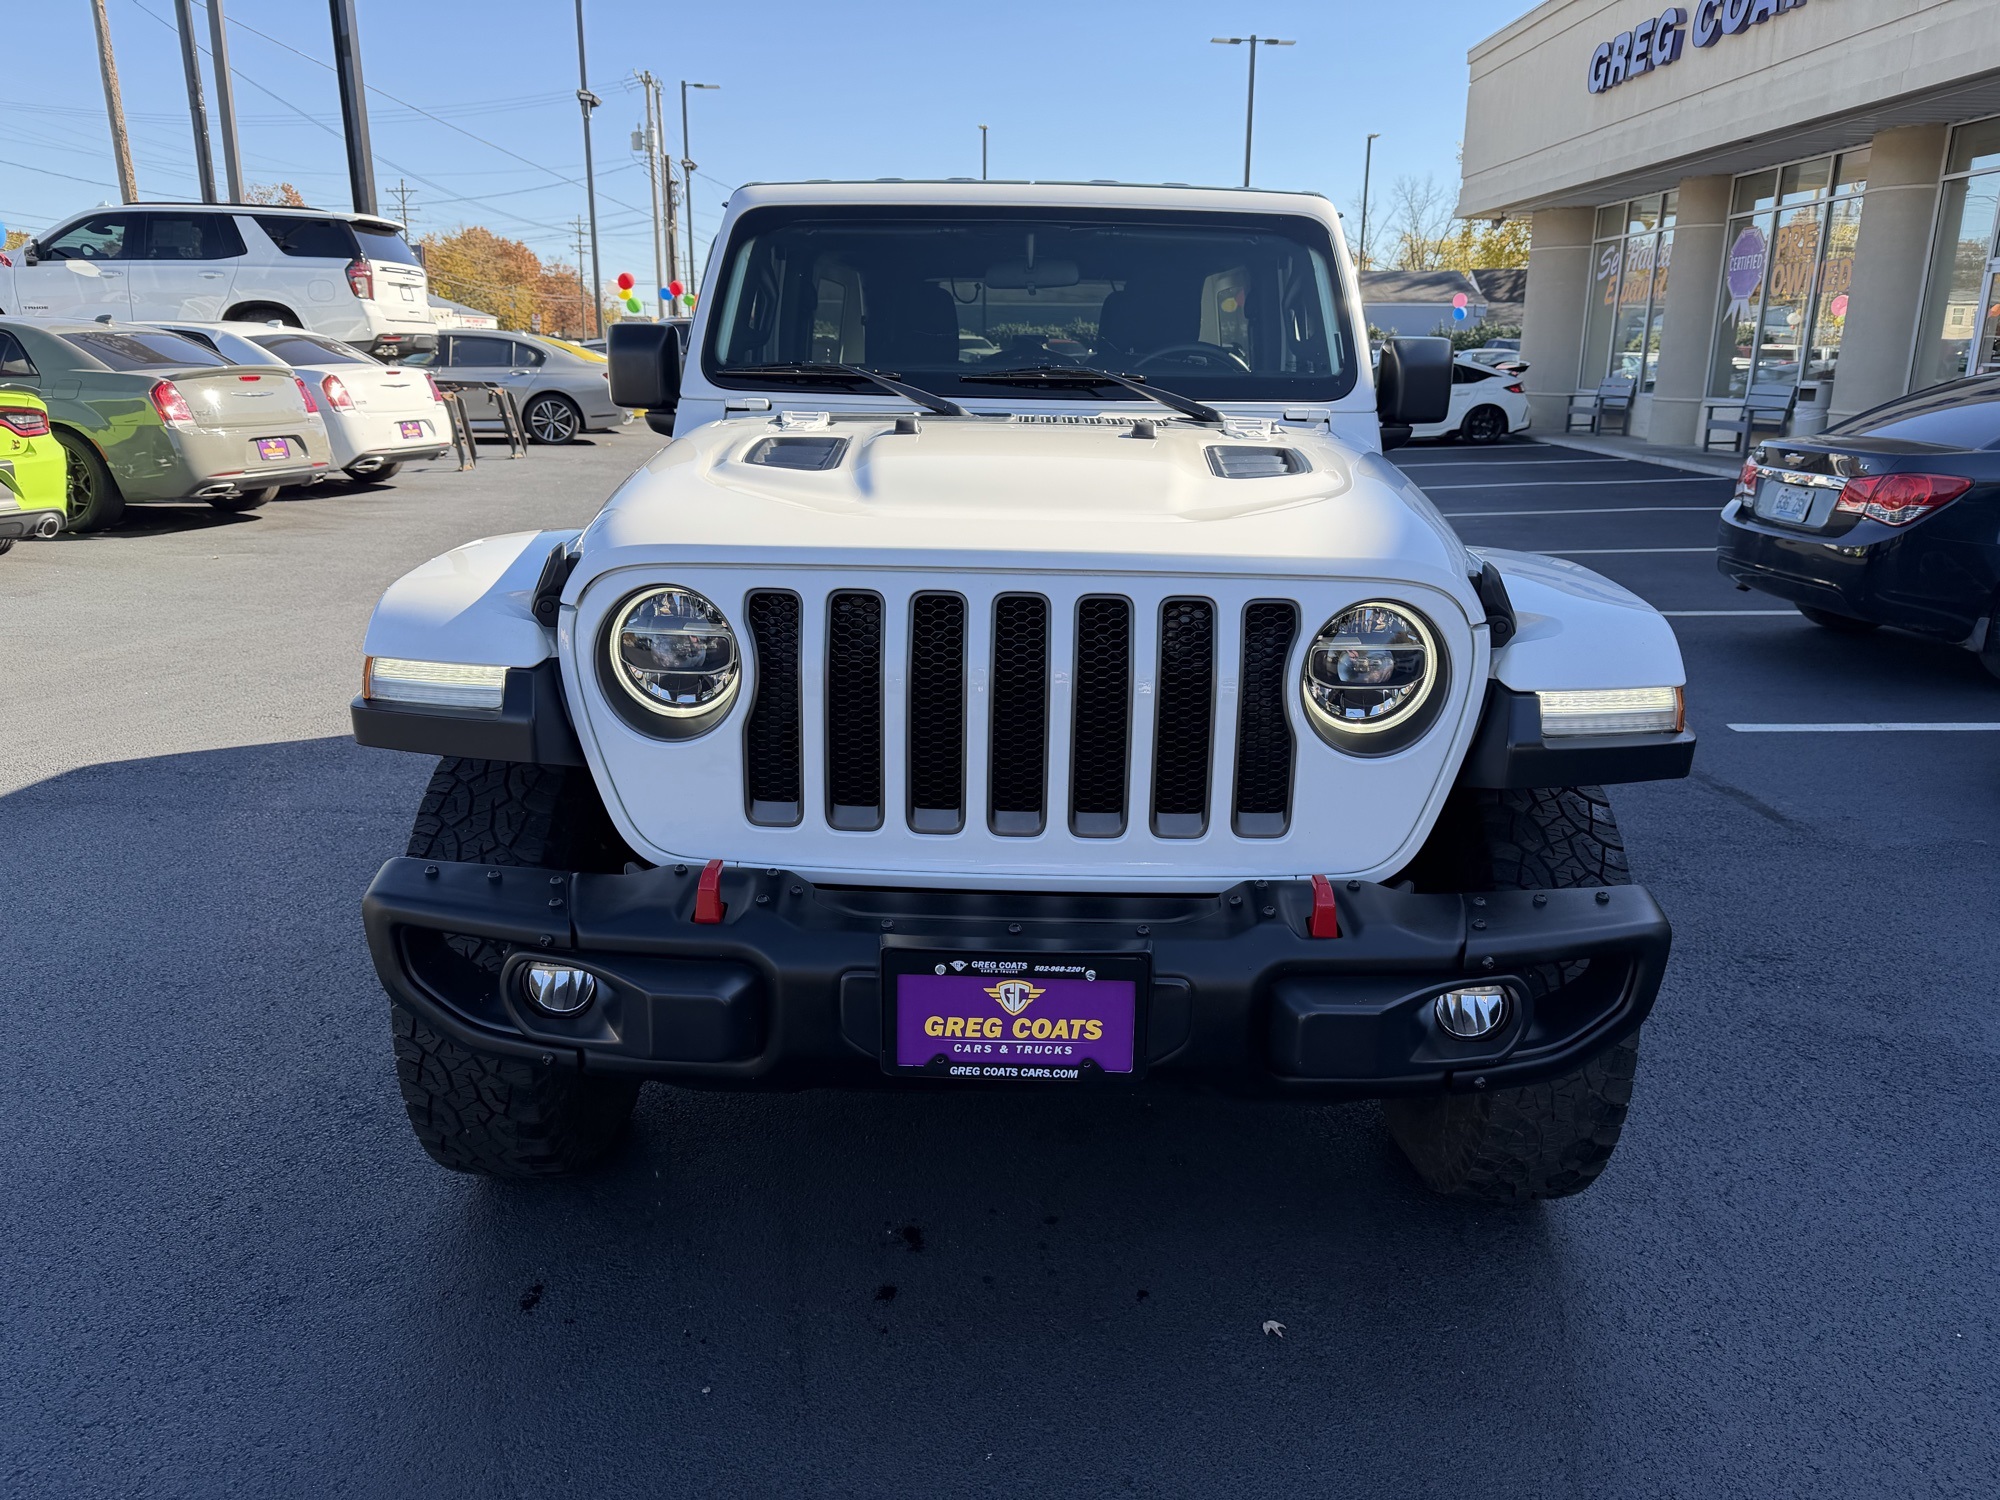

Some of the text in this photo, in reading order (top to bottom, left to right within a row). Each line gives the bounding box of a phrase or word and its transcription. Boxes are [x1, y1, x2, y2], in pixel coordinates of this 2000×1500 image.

[1588, 0, 1802, 95] GREG CO
[1775, 222, 1819, 260] PRE
[1597, 245, 1620, 281] Se
[1729, 253, 1763, 272] CERTIFIED
[1769, 258, 1853, 298] OWNED
[971, 960, 1028, 970] GREG COATS
[1033, 965, 1086, 973] 502-968-2201
[1000, 982, 1030, 1012] GC
[924, 1015, 1104, 1040] GREG COATS
[953, 1043, 1074, 1055] CARS & TRUCKS
[949, 1066, 1079, 1079] GREG COATS CARS.COM
